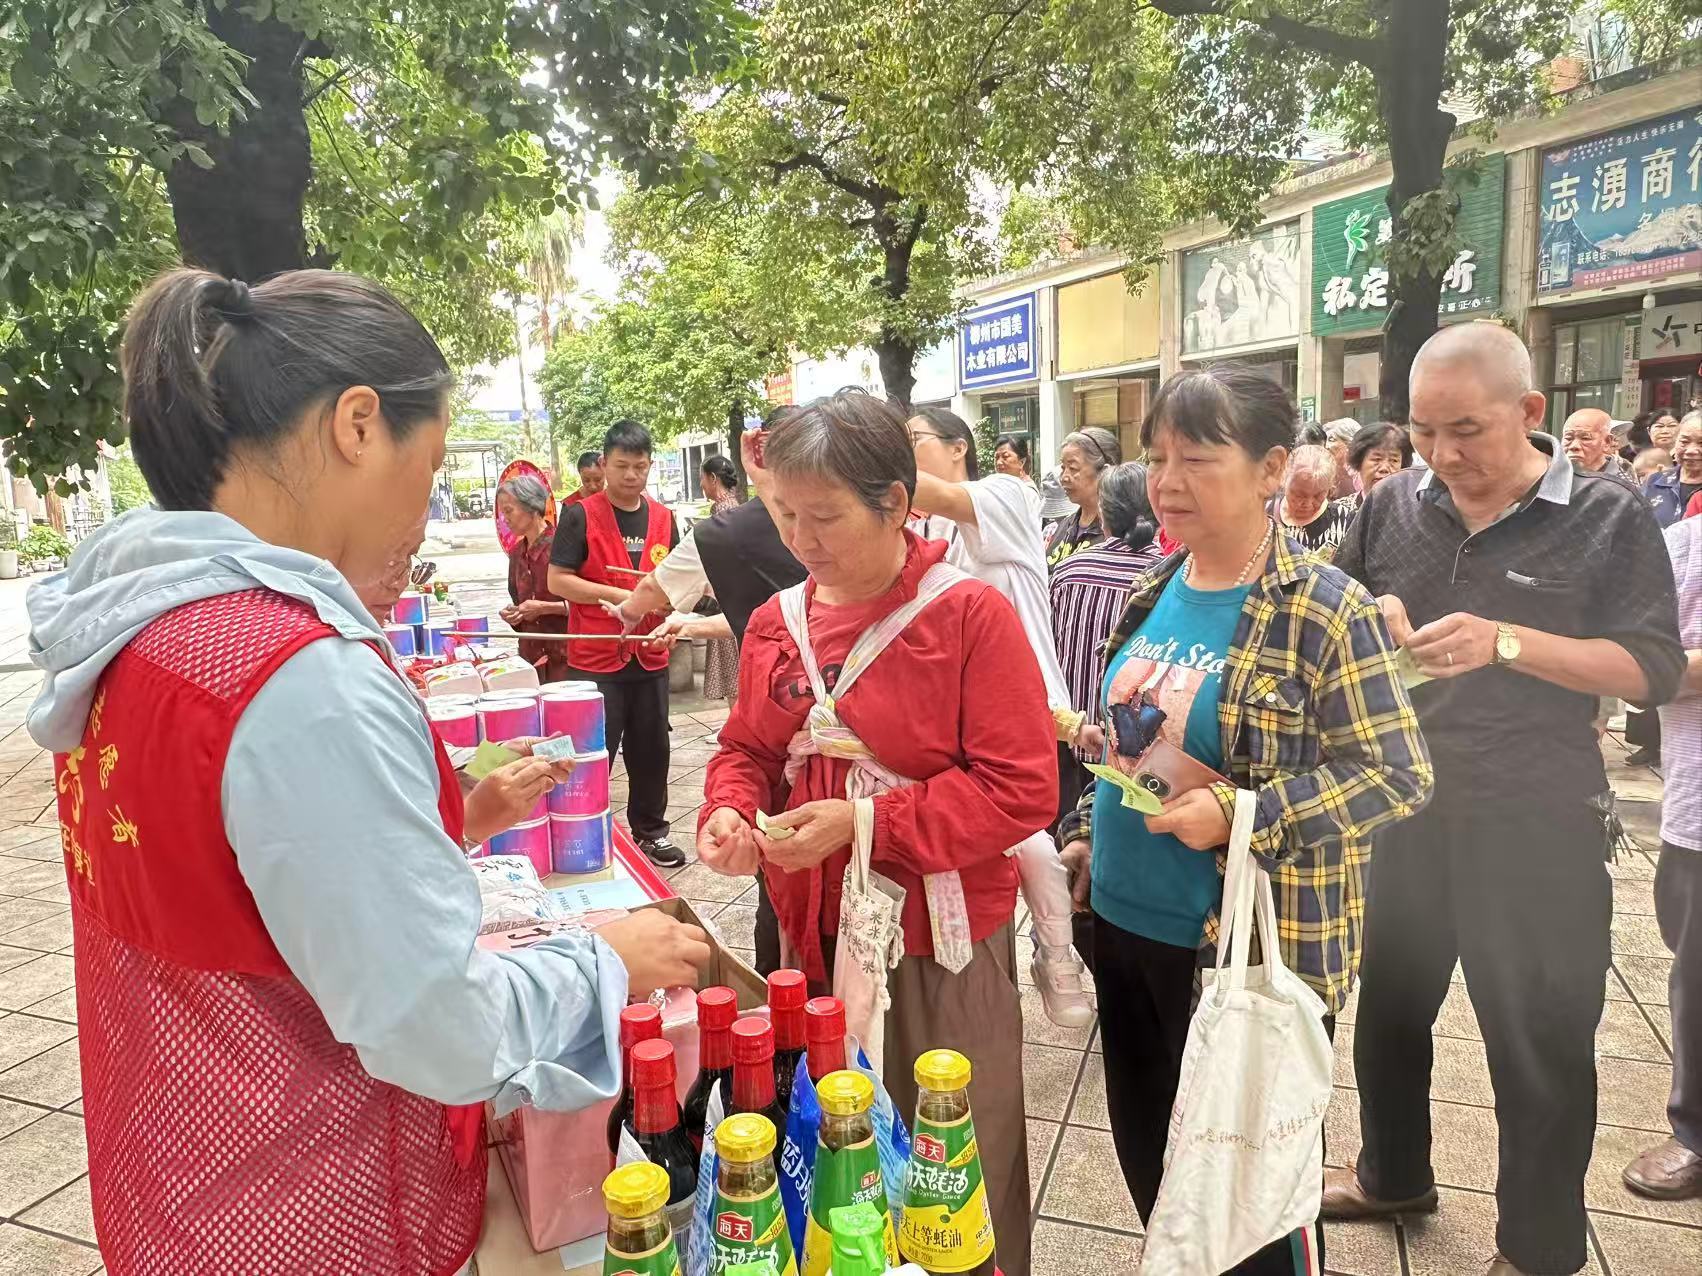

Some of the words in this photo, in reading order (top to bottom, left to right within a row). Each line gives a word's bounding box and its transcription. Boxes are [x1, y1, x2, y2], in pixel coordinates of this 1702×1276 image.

[967, 342, 1027, 372] 木业有限公司
[1123, 635, 1176, 662] Don't
[1179, 644, 1226, 683] Sto
[915, 1138, 941, 1160] 海天
[720, 1219, 748, 1238] 海天
